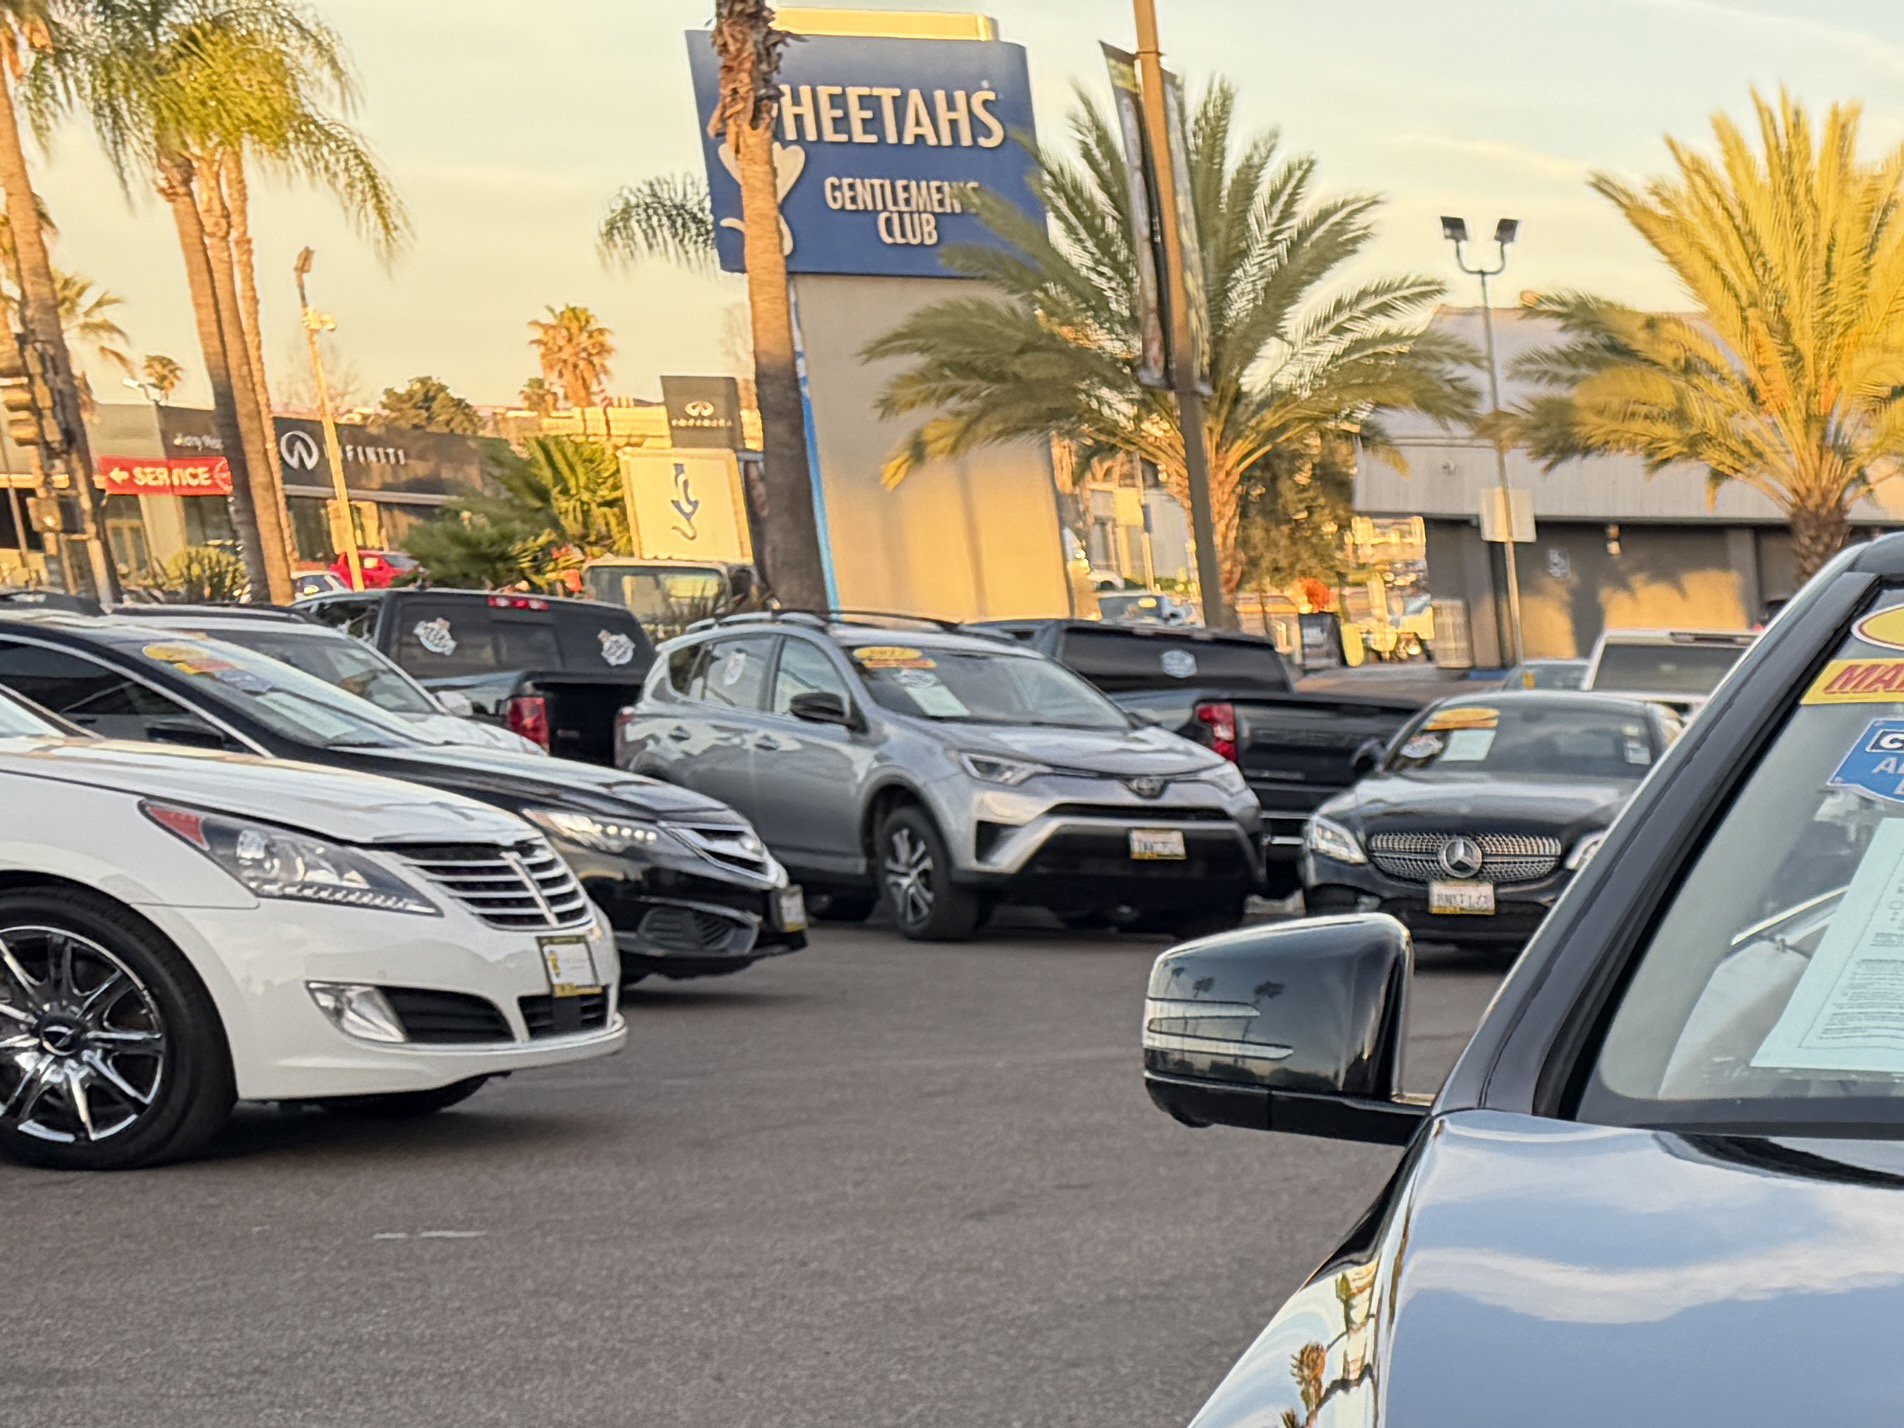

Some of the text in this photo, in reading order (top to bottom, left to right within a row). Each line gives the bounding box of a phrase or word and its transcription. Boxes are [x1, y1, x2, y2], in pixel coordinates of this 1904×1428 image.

[772, 84, 1005, 148] HEETAHS
[876, 211, 938, 245] CLUB
[132, 466, 213, 487] SERVICE
